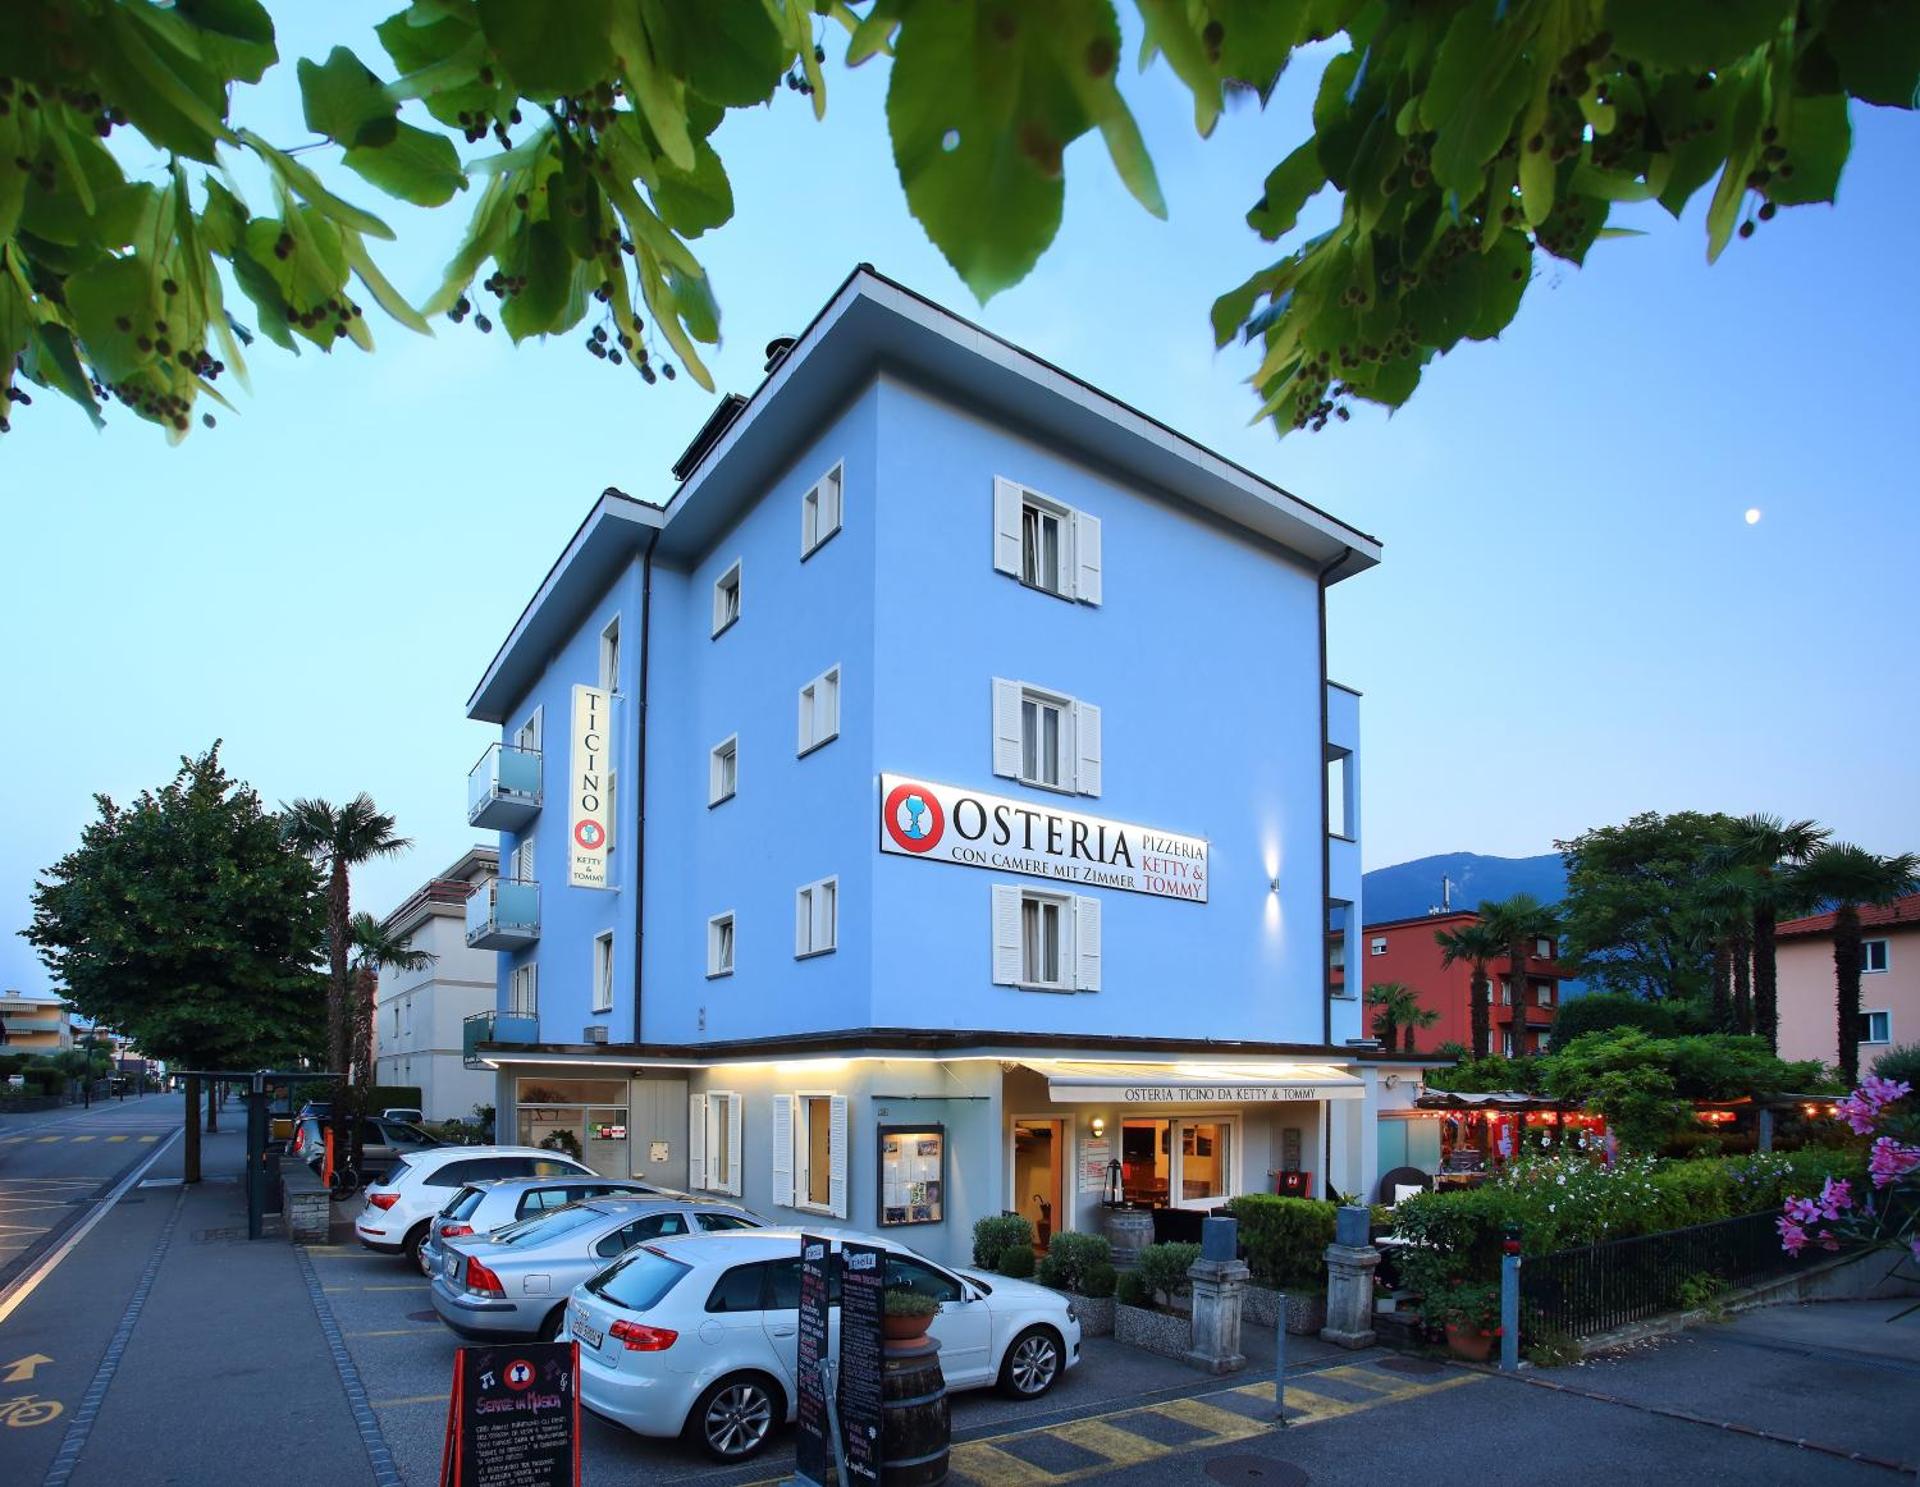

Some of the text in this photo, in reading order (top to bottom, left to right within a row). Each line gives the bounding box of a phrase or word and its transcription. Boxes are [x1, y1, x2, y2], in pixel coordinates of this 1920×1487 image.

[582, 693, 600, 812] TICINO
[953, 798, 1134, 868] OSTERIA
[1142, 834, 1204, 861] PIZZERIA
[576, 856, 601, 865] KETTY
[952, 846, 1135, 888] CON CAMERE MIT ZIMMER
[1142, 856, 1203, 881] KETTY &
[574, 872, 604, 882] TOMMY
[1143, 874, 1204, 899] TOMMY
[1125, 1088, 1315, 1101] OSTERIA TICINO DA KETTY & TOMMY
